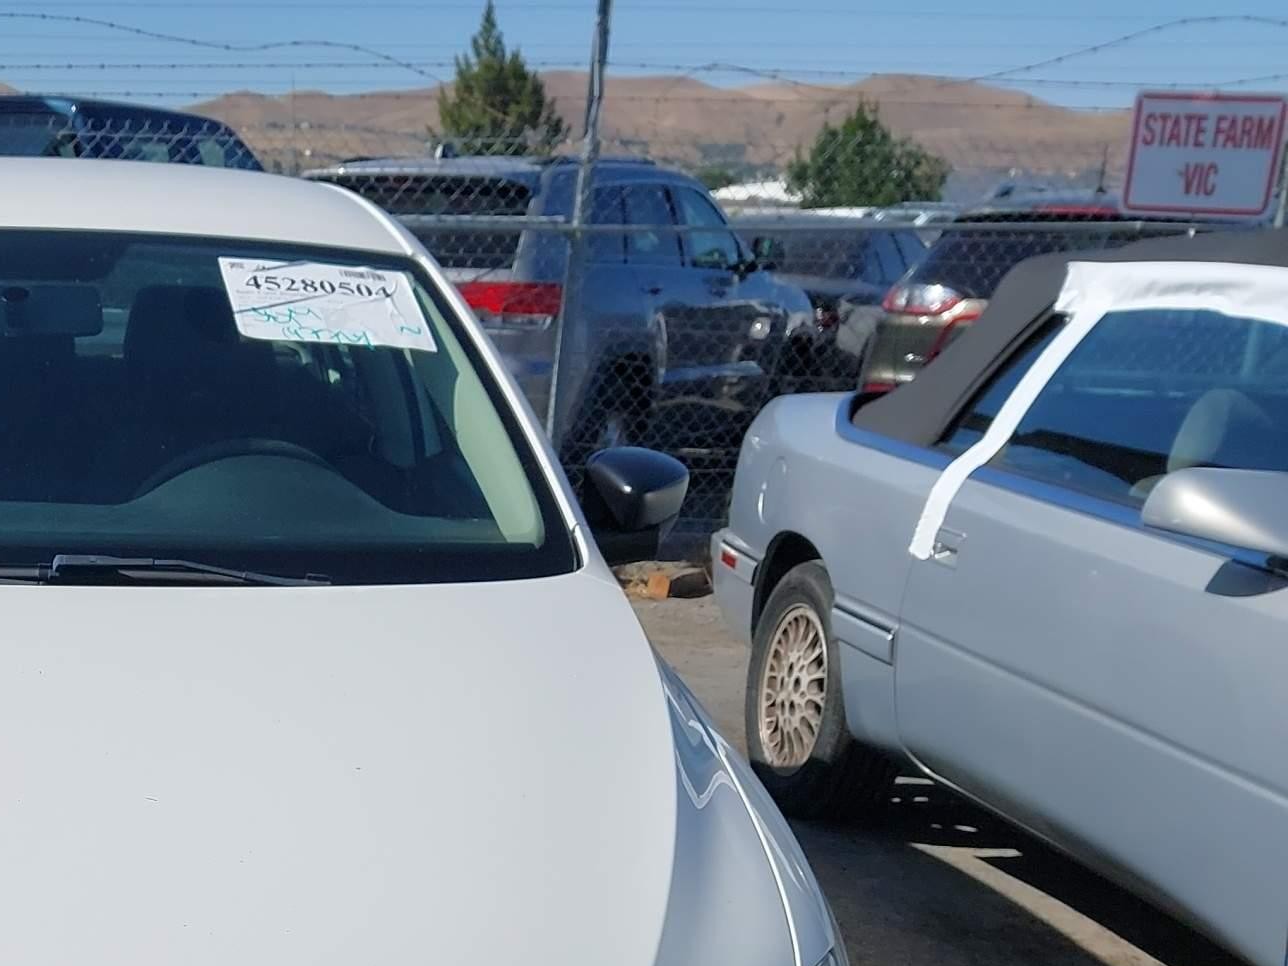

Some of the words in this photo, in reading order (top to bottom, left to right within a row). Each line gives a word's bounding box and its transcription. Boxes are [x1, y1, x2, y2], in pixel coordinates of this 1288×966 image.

[1142, 112, 1209, 147] STATE
[1212, 114, 1275, 149] FARM
[1183, 161, 1218, 196] VIC
